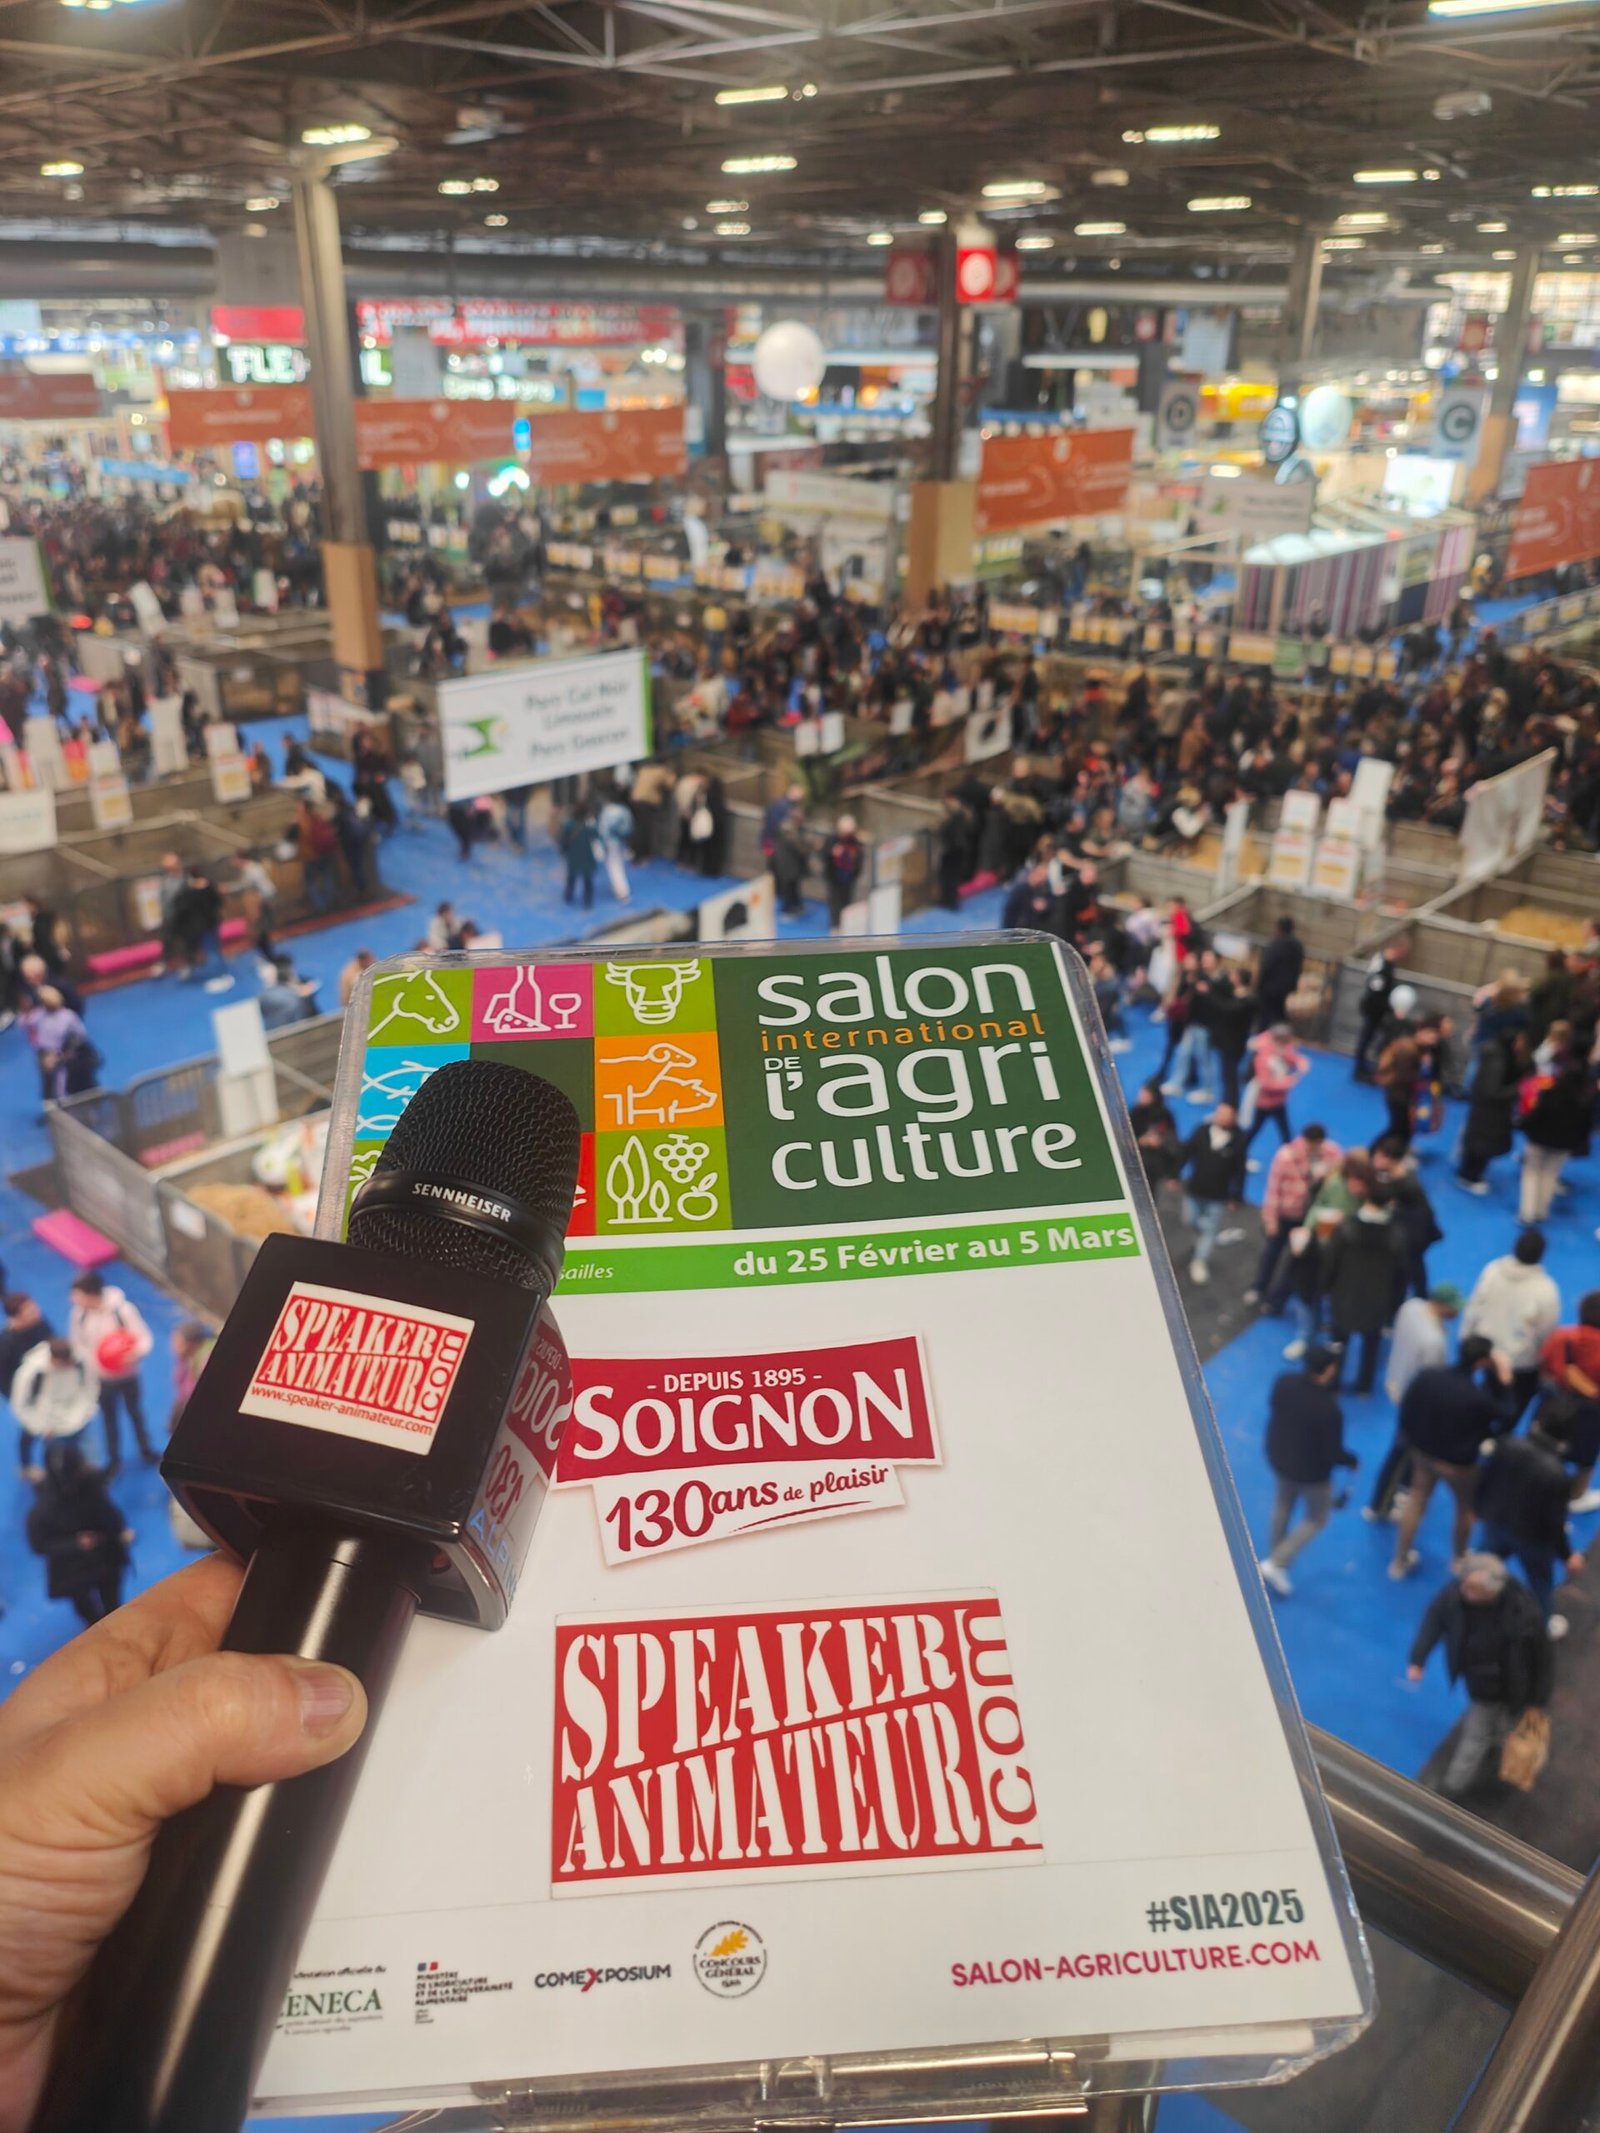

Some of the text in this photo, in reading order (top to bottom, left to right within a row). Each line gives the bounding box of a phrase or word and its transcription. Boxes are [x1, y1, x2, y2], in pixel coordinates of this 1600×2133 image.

[757, 955, 1035, 1026] salon
[761, 1012, 1046, 1052] international
[764, 1056, 801, 1071] DE
[771, 1122, 1082, 1190] culture
[412, 1182, 512, 1222] SENNHEISER
[733, 1226, 1135, 1276] du 25 Février au 5 Mars
[271, 1299, 438, 1359] SPEAKER
[259, 1351, 426, 1415] ANIMATEUR
[663, 1367, 806, 1393] DEPUIS 1895
[251, 1384, 433, 1436] www.speaker-animateur.com
[573, 1368, 913, 1460] SOIGNON
[783, 1485, 804, 1502] de
[810, 1464, 889, 1502] plaisir
[561, 1613, 957, 1784] SPEAKER
[559, 1700, 981, 1873] ANIMATEUR
[1146, 1888, 1305, 1933] #SIA2025
[534, 1963, 672, 1993] COMEXPOSIUM
[699, 1955, 762, 1969] CONCOURS
[950, 1939, 1321, 1987] SALON-AGRICULTURE.COM
[280, 1988, 382, 2017] ENECA
